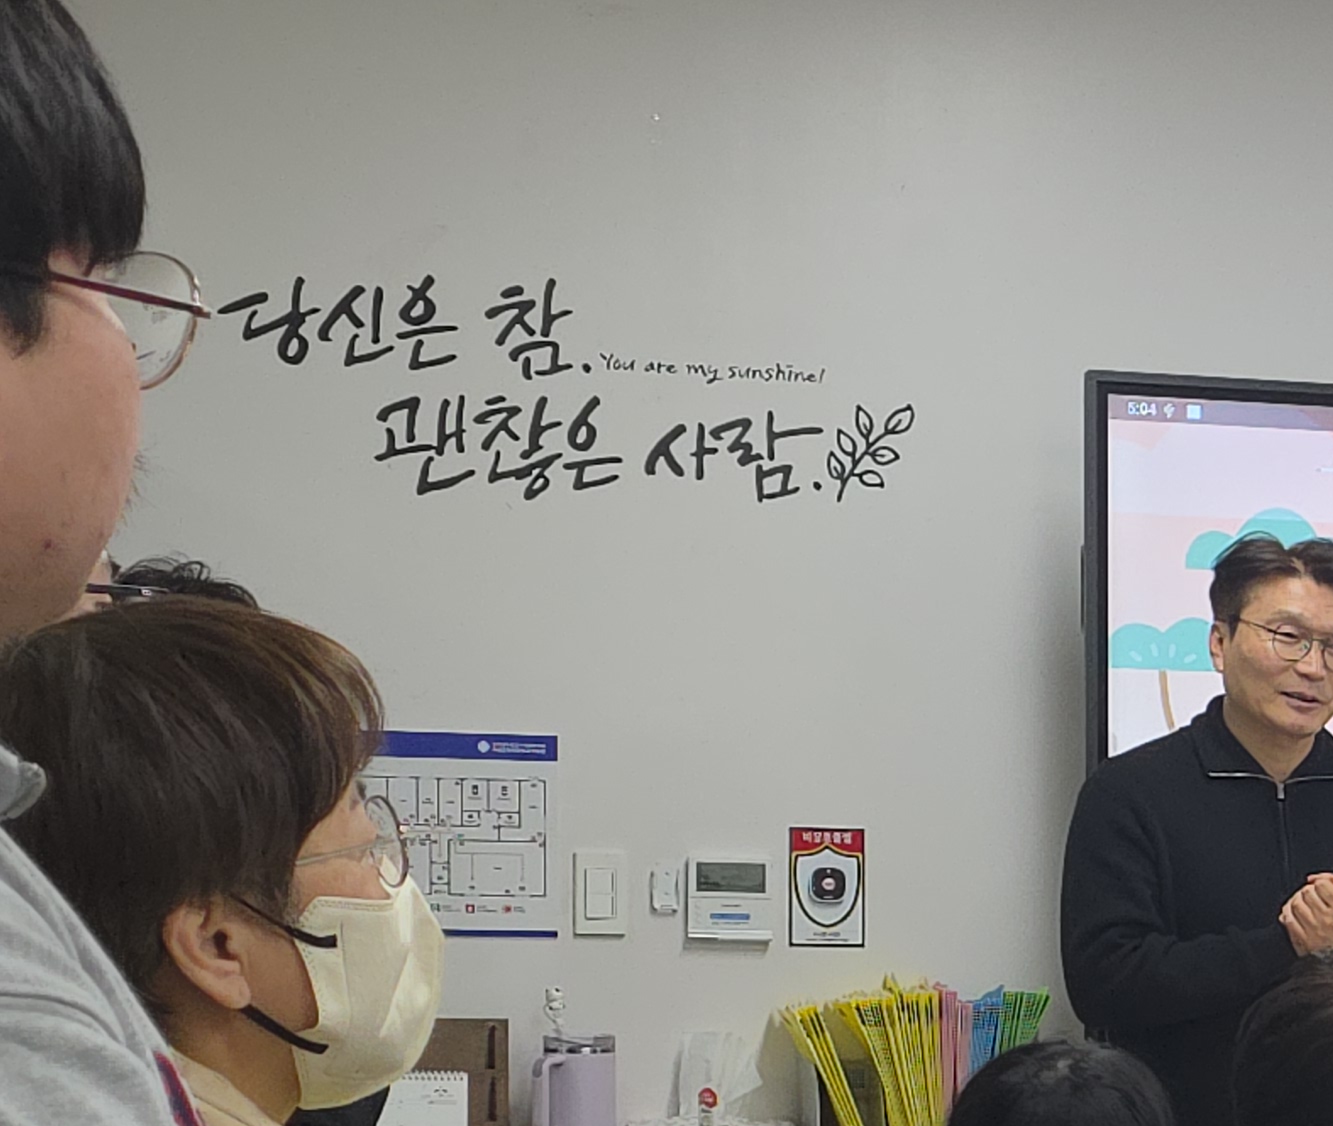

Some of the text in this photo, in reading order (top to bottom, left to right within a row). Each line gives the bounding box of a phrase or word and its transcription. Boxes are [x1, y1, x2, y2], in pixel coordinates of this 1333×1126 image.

[217, 274, 592, 381] 당신은 참.
[599, 352, 826, 385] You are my sunshine!
[1127, 401, 1158, 417] 5:04
[373, 394, 824, 503] 괜찮은 사람.
